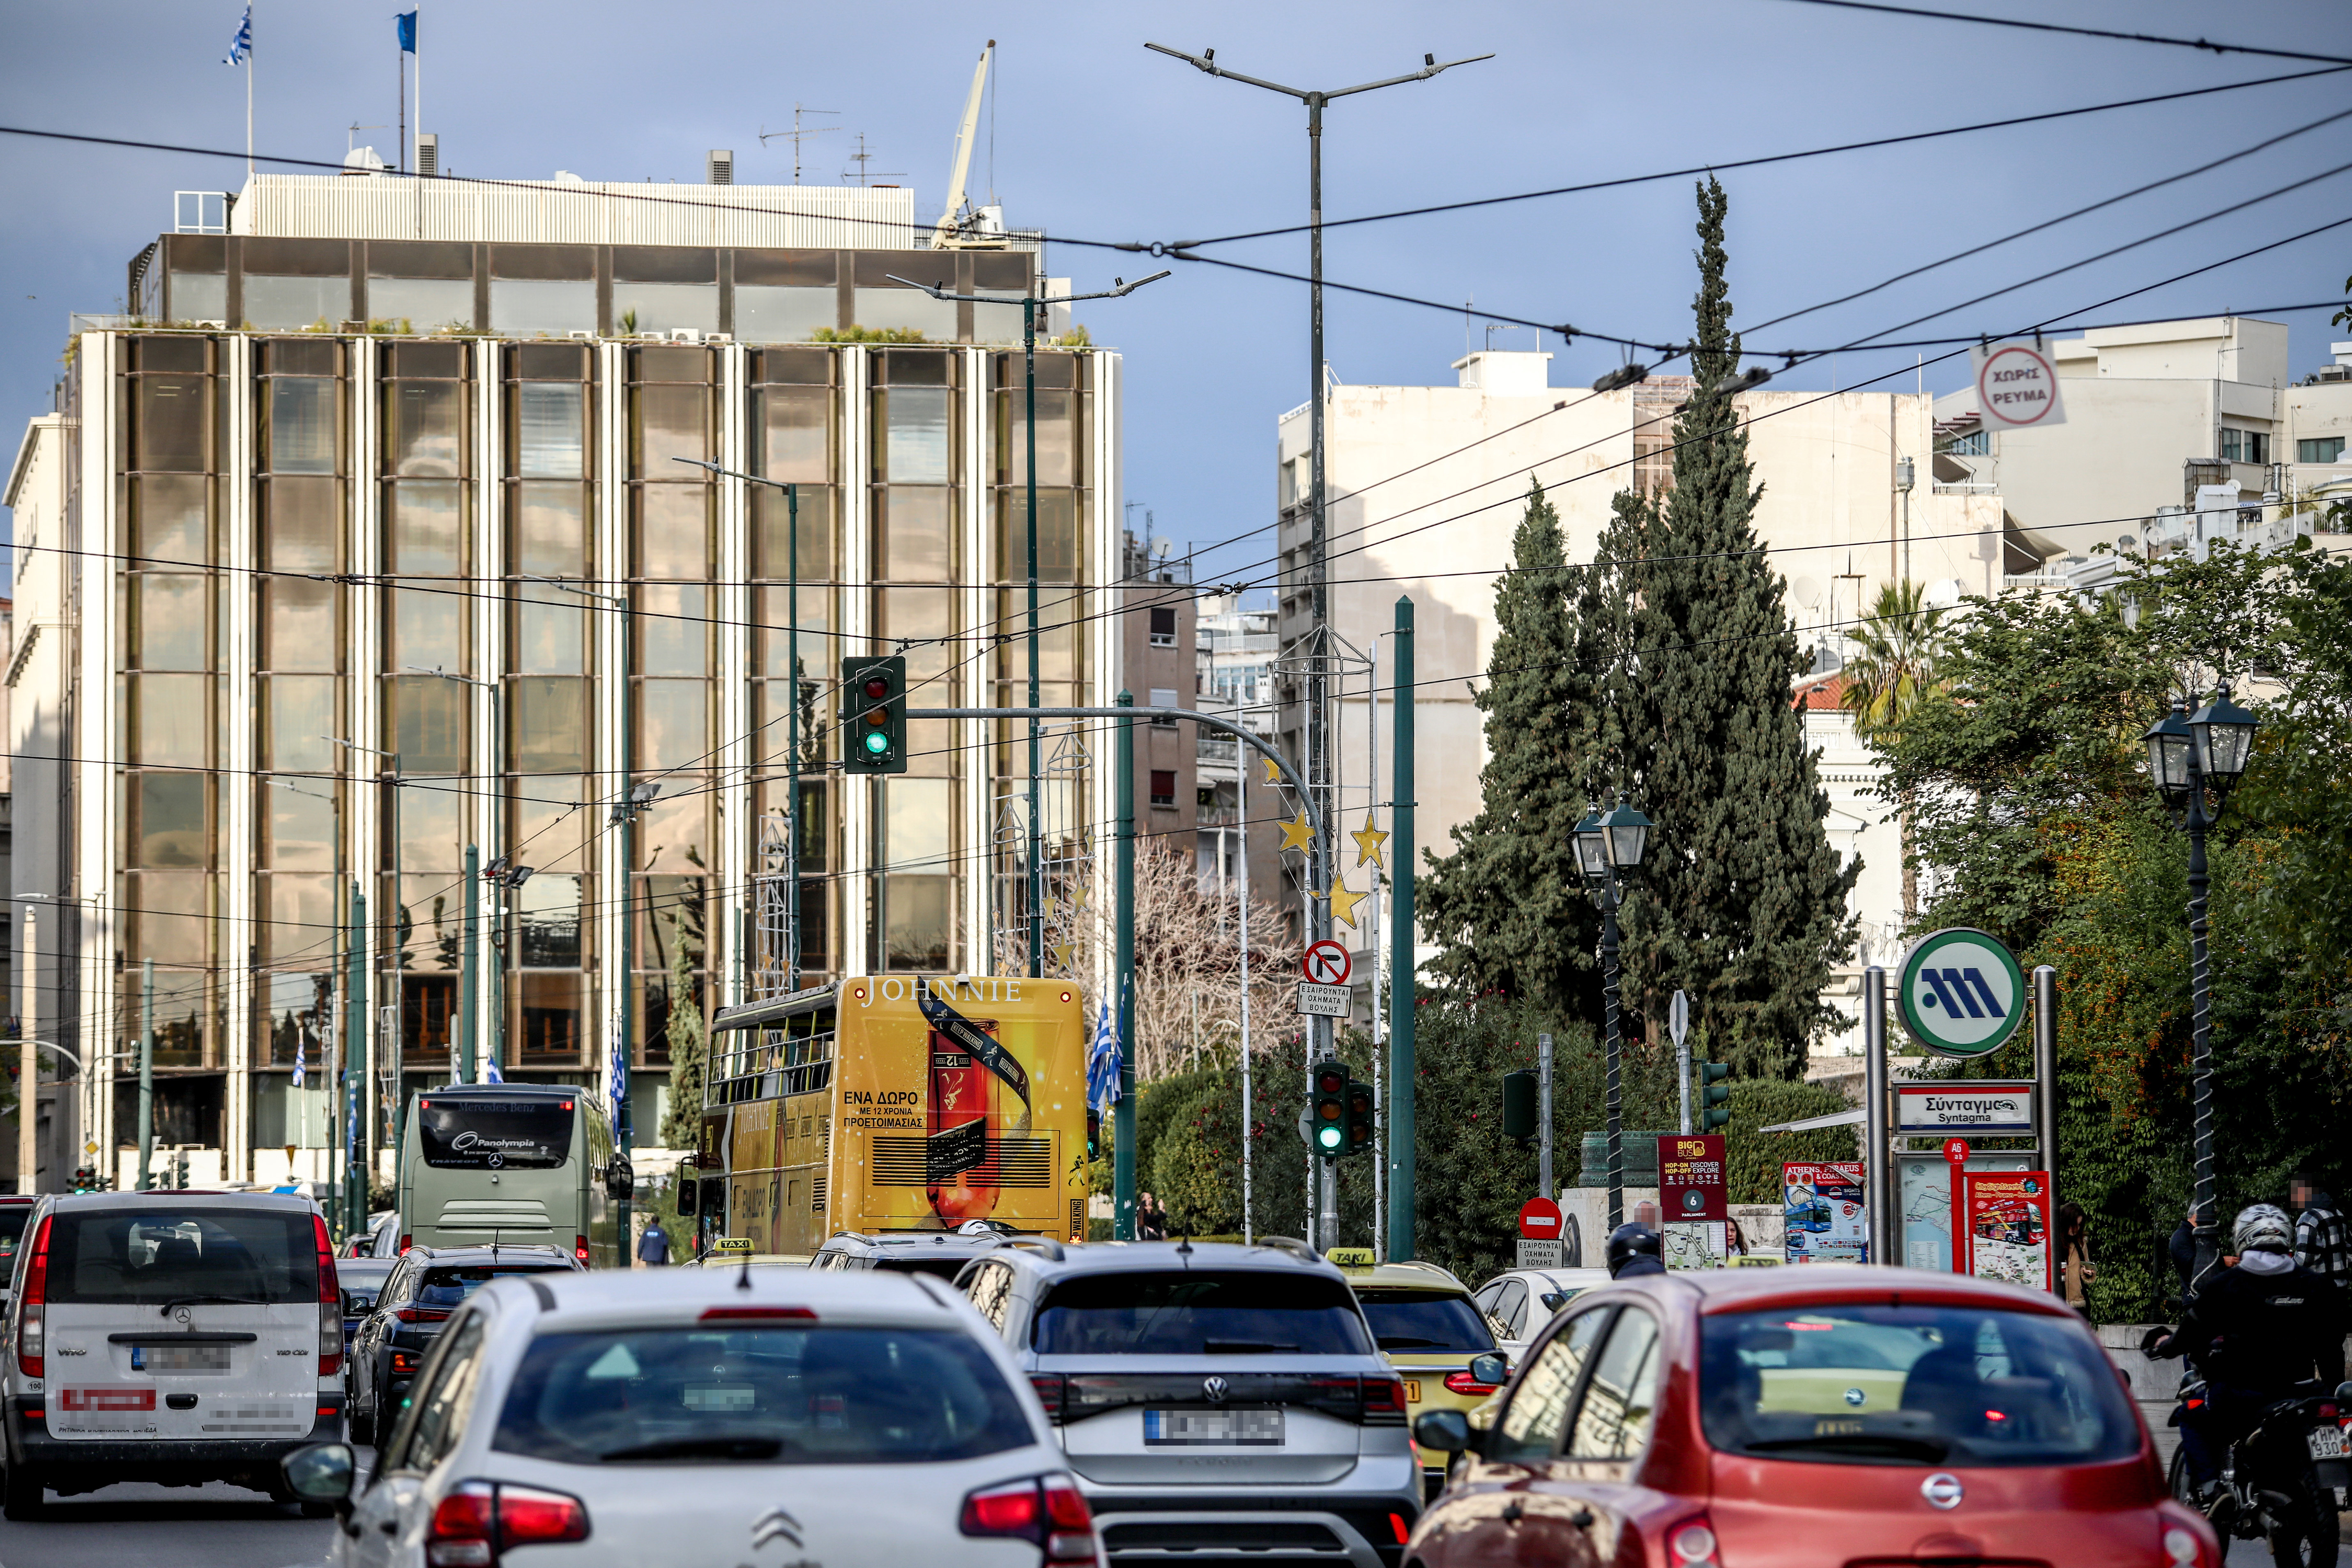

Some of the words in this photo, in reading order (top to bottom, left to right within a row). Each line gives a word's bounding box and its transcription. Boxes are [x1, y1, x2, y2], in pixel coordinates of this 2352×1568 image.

[1993, 368, 2040, 383] ΧΩΡΙΣ
[1993, 389, 2047, 404] ΡΕΥΜΑ
[861, 976, 1022, 1007] JOHNNIE
[1302, 986, 1348, 997] ΕΞΑΙΡΟΥΝΤΑΙ
[1308, 995, 1341, 1004] ΟΧΗΜΑΤΑ
[1309, 1004, 1338, 1013] ΒΟΥΛΗΣ
[952, 1023, 963, 1034] KEEP
[963, 1030, 981, 1048] WALKING
[845, 1091, 873, 1104] ΕΝΑ
[877, 1091, 918, 1105] ΔΩΡΟ
[458, 1102, 535, 1112] Mercedes-Benz
[844, 1118, 922, 1127] ΠΡΟΕΤΟΙΜΑΣΙΑΣ
[1939, 1113, 1991, 1124] Syntagma
[478, 1139, 534, 1148] Panolympia
[1951, 1143, 1961, 1153] A6
[1975, 1182, 2026, 1191] CitySightseeing
[1690, 1196, 1697, 1206] 6
[1073, 1202, 1082, 1231] WALKING
[2315, 1441, 2339, 1455] 930
